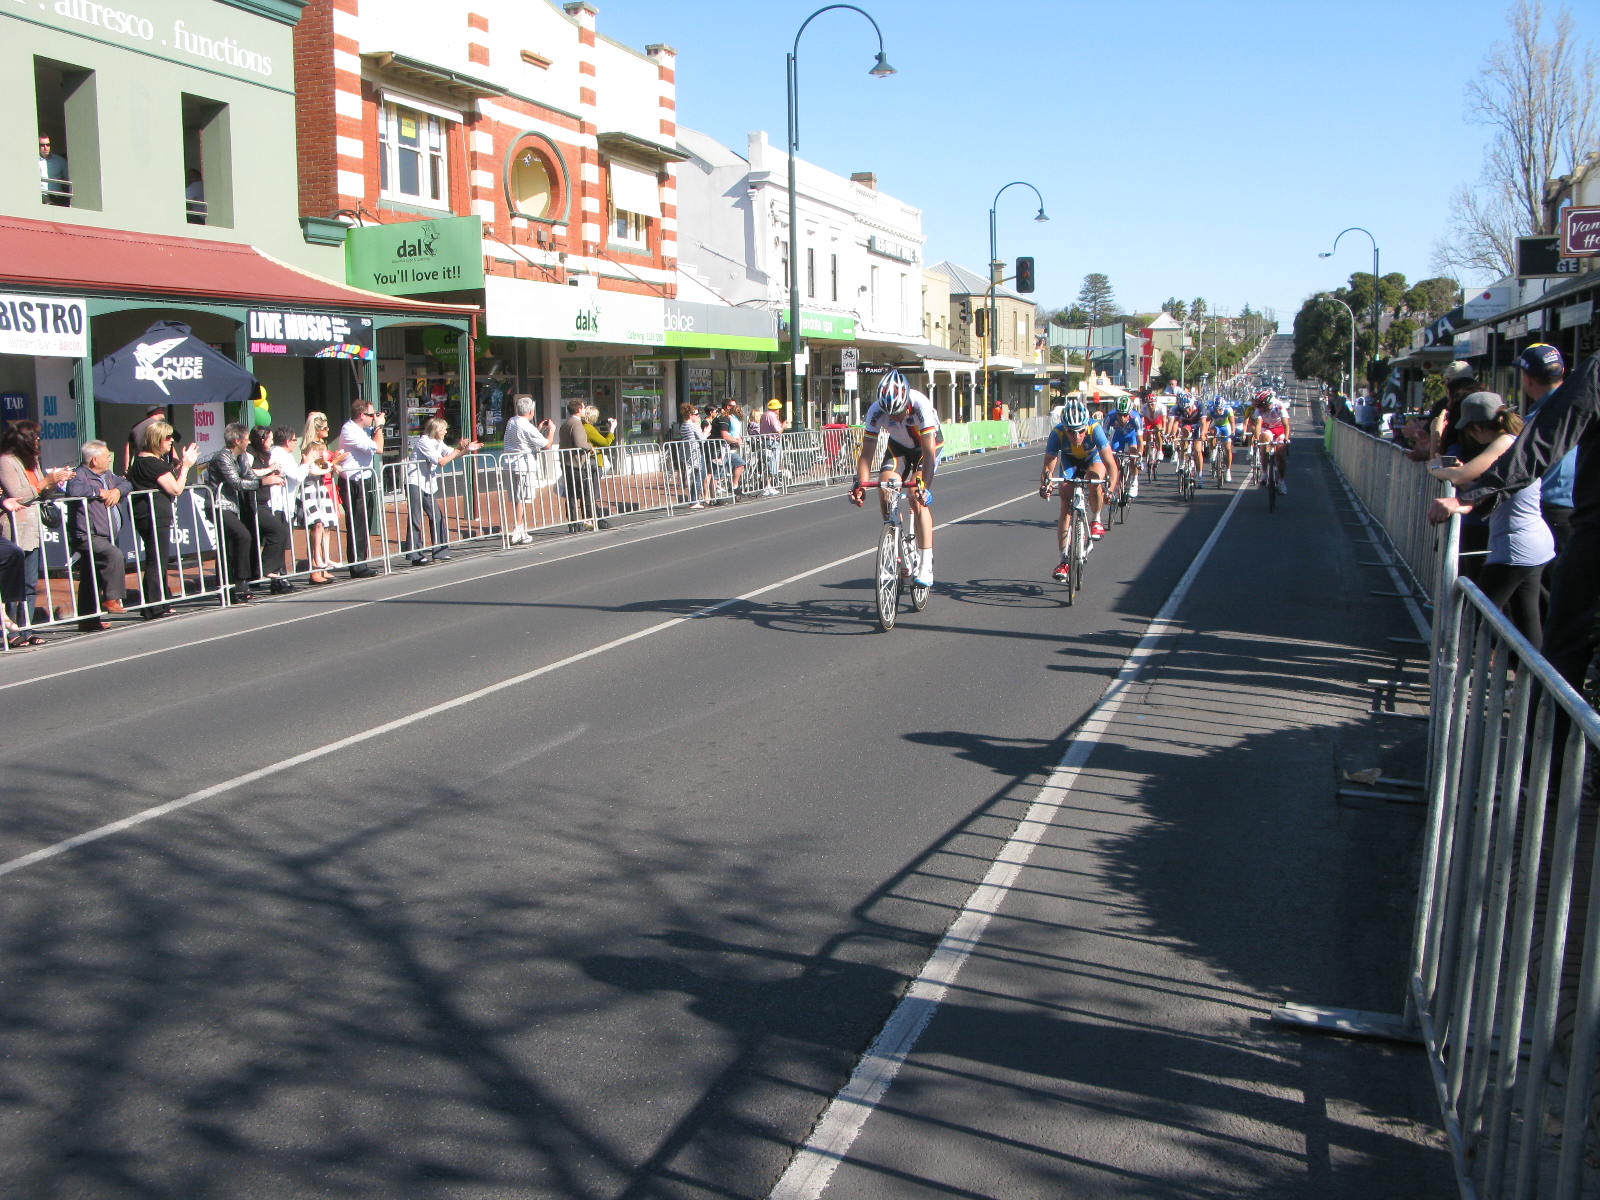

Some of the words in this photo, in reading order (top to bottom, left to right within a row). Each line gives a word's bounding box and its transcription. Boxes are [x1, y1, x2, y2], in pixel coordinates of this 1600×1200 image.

[54, 0, 154, 41] alfresco
[174, 20, 272, 76] functions
[374, 269, 408, 285] You'll
[412, 268, 440, 282] love
[442, 265, 461, 280] it!!
[0, 300, 82, 335] BISTRO
[250, 311, 283, 340] LIVE
[284, 313, 333, 342] MUSIC
[664, 308, 694, 331] dolce
[251, 342, 260, 353] All
[260, 343, 287, 354] Welcome
[163, 356, 203, 368] PURE
[4, 397, 24, 410] TAB
[44, 396, 57, 416] All
[40, 420, 77, 440] elcome
